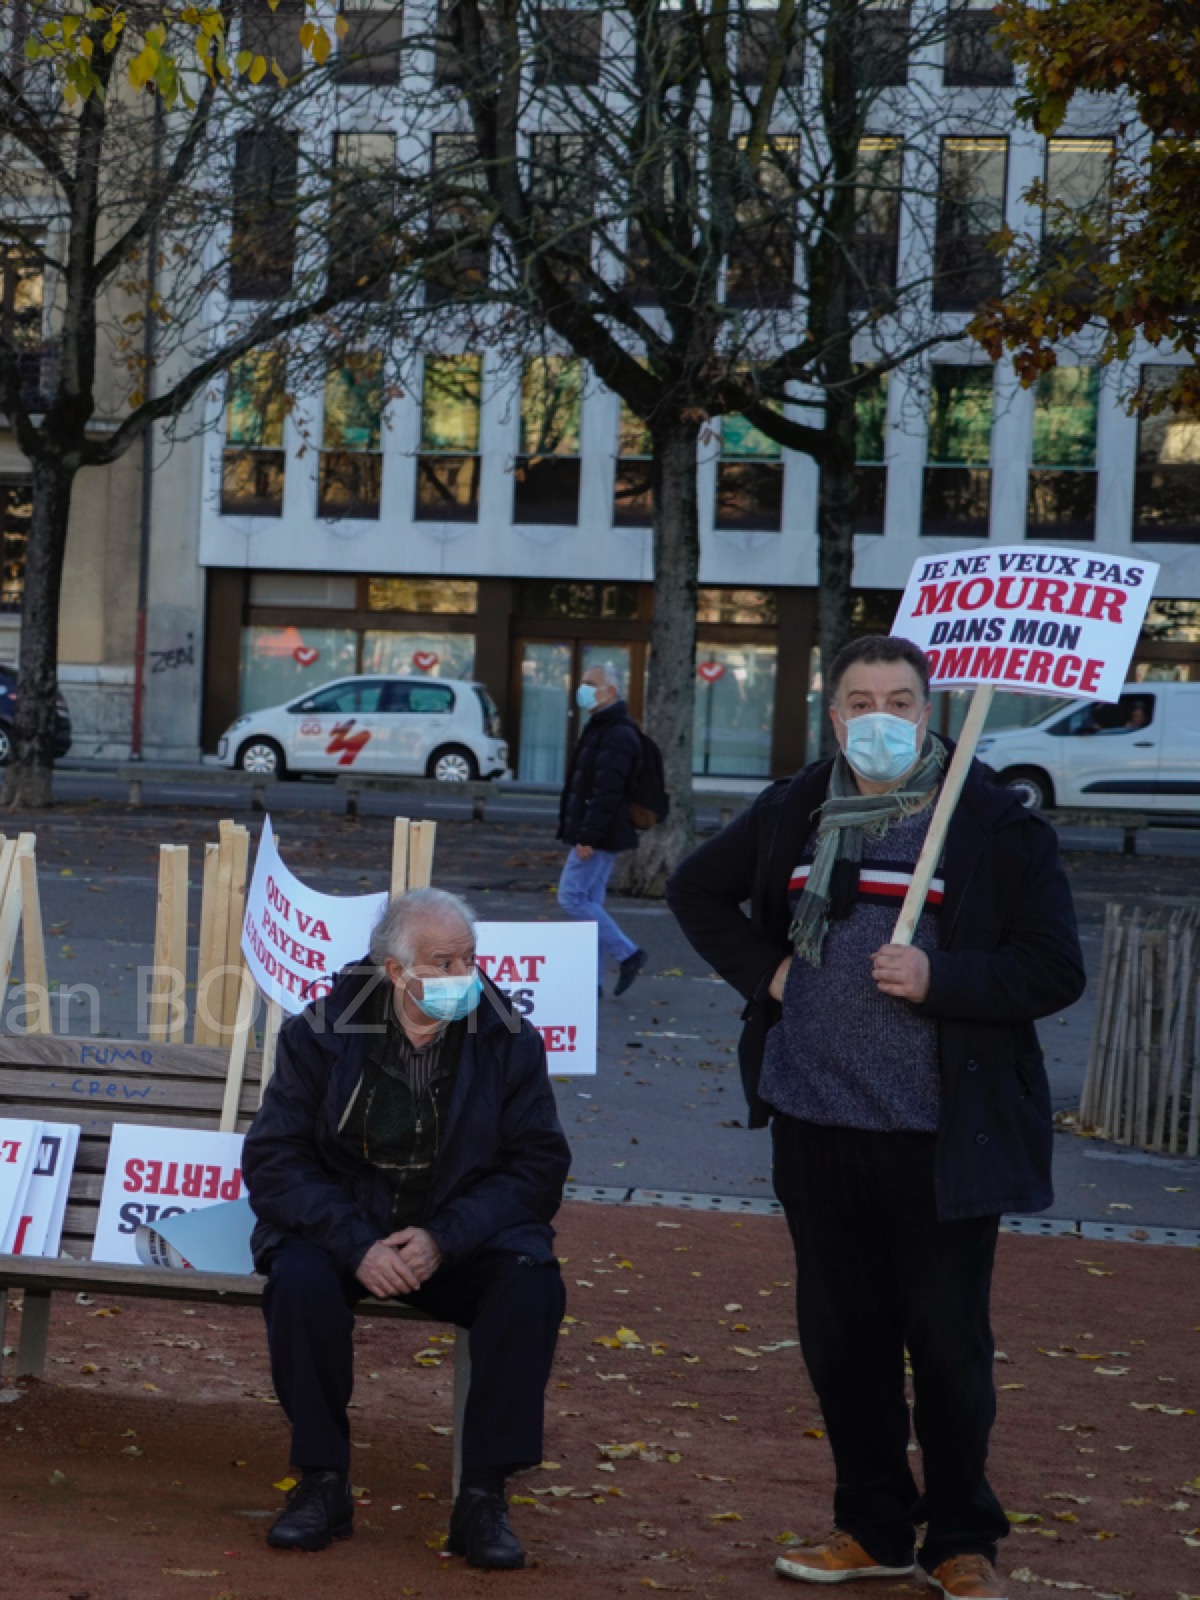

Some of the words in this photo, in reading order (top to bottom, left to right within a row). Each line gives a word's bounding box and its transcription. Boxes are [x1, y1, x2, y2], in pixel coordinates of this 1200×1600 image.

[918, 561, 948, 583] JE
[951, 556, 990, 577] NE
[998, 554, 1080, 577] VEUX
[1083, 560, 1144, 587] PAS
[910, 577, 1127, 623] MOURIR
[929, 617, 1006, 646] DANS
[1009, 618, 1082, 650] MON
[924, 646, 1105, 693] OMMERCE
[266, 875, 291, 921] QUI
[295, 908, 332, 942] VA
[262, 905, 327, 972] PAYER
[475, 955, 546, 982] TAT
[123, 1157, 243, 1201] PERTES
